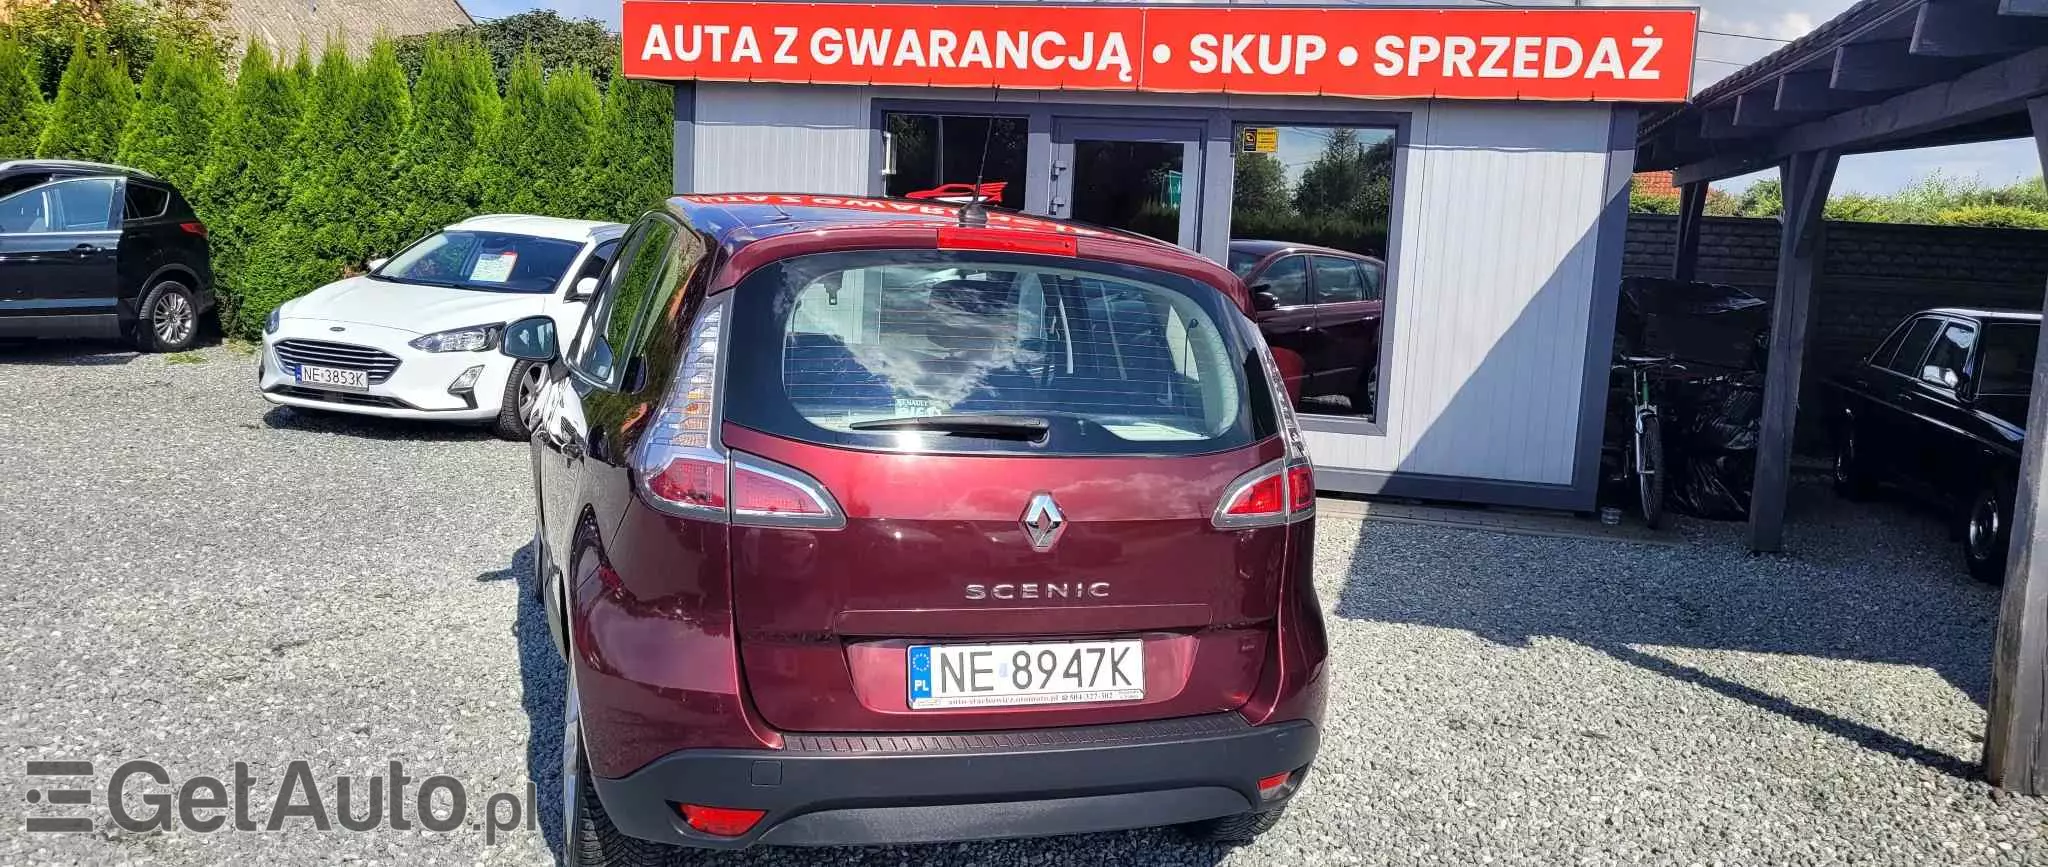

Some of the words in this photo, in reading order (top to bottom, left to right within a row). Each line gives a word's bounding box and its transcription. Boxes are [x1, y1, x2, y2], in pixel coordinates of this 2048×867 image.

[640, 24, 761, 63] AUTA
[773, 27, 798, 64] Z
[809, 28, 1133, 82] GWARANCJĄ
[1189, 33, 1327, 75] SKUP
[1373, 25, 1664, 80] SPRZEDAŻ
[304, 367, 320, 382] NE
[325, 369, 364, 387] 3853K
[965, 582, 1111, 600] SCENIC
[940, 650, 994, 693] NE
[1012, 647, 1132, 690] 8947K
[914, 680, 930, 692] PL
